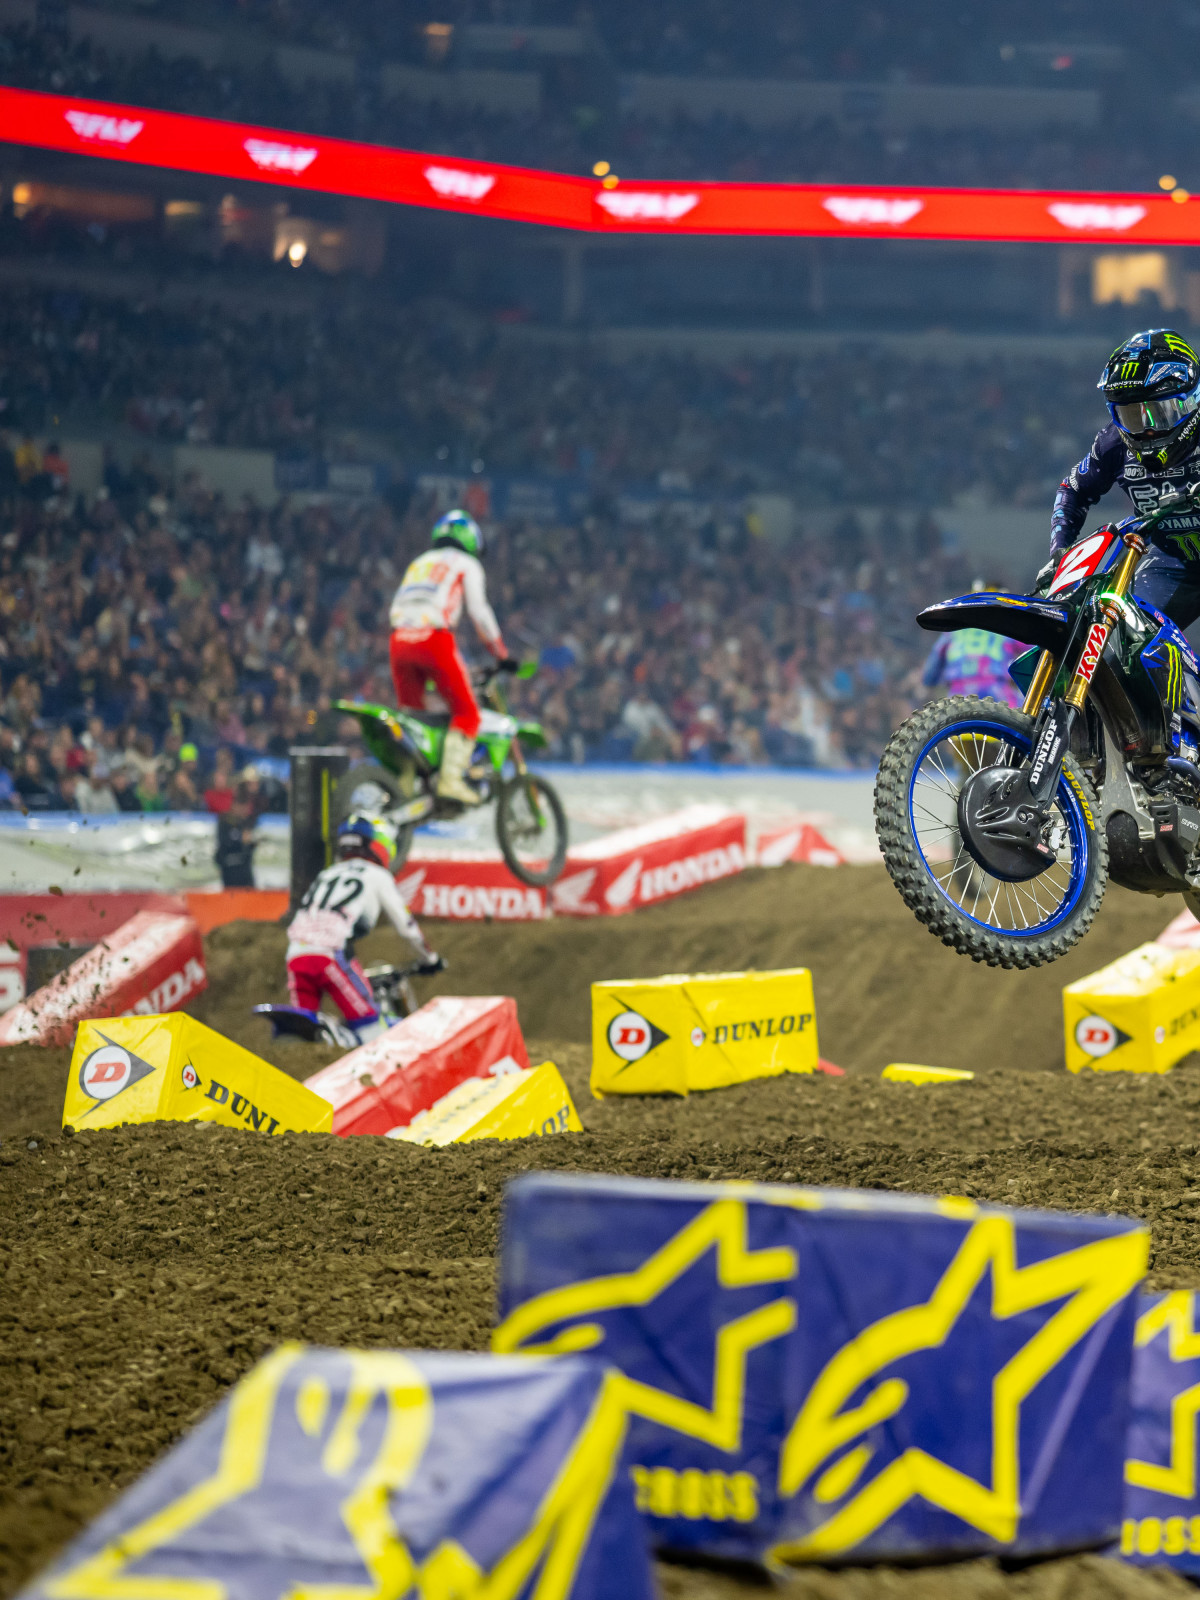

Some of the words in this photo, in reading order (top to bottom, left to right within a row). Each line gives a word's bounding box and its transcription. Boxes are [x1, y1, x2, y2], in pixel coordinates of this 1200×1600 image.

[1106, 380, 1143, 389] MONSTER
[1124, 466, 1145, 478] 100%
[1044, 534, 1106, 601] 2
[1076, 623, 1108, 685] KYB
[1030, 718, 1058, 785] DUNLOP
[1063, 770, 1096, 831] DUNLOP
[422, 885, 544, 913] HONDA
[614, 1028, 647, 1046] D
[712, 1014, 813, 1045] DUNLOP
[1084, 1028, 1111, 1044] D
[87, 1062, 127, 1085] D
